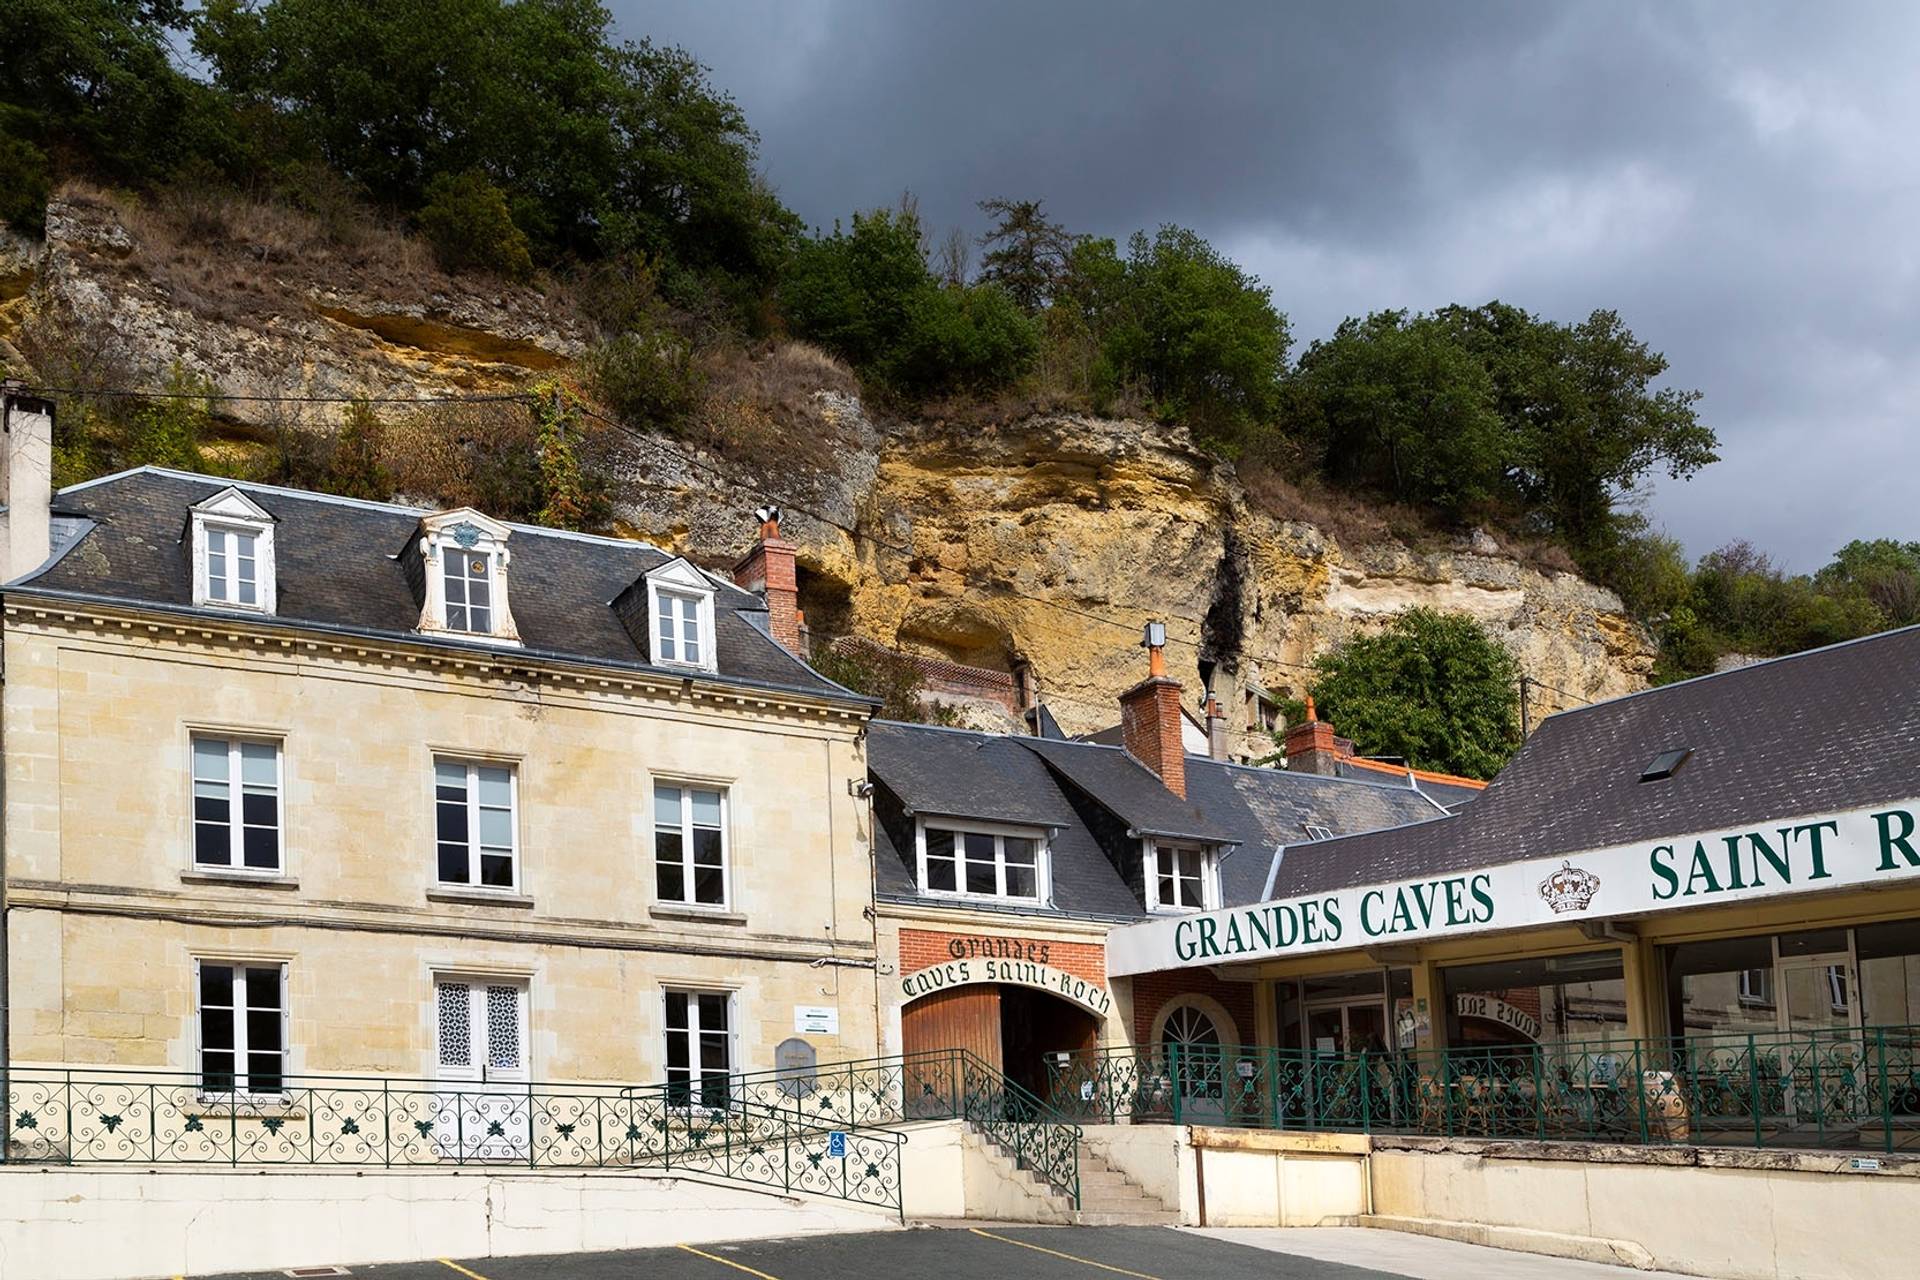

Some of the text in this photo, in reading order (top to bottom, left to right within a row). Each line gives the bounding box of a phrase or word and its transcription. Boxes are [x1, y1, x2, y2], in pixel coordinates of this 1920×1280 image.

[1175, 897, 1343, 963] GRANDES
[1359, 873, 1495, 938] CAVES
[1651, 819, 1839, 901] SAINT
[949, 938, 1050, 965] Grandes
[902, 961, 970, 997] Caves
